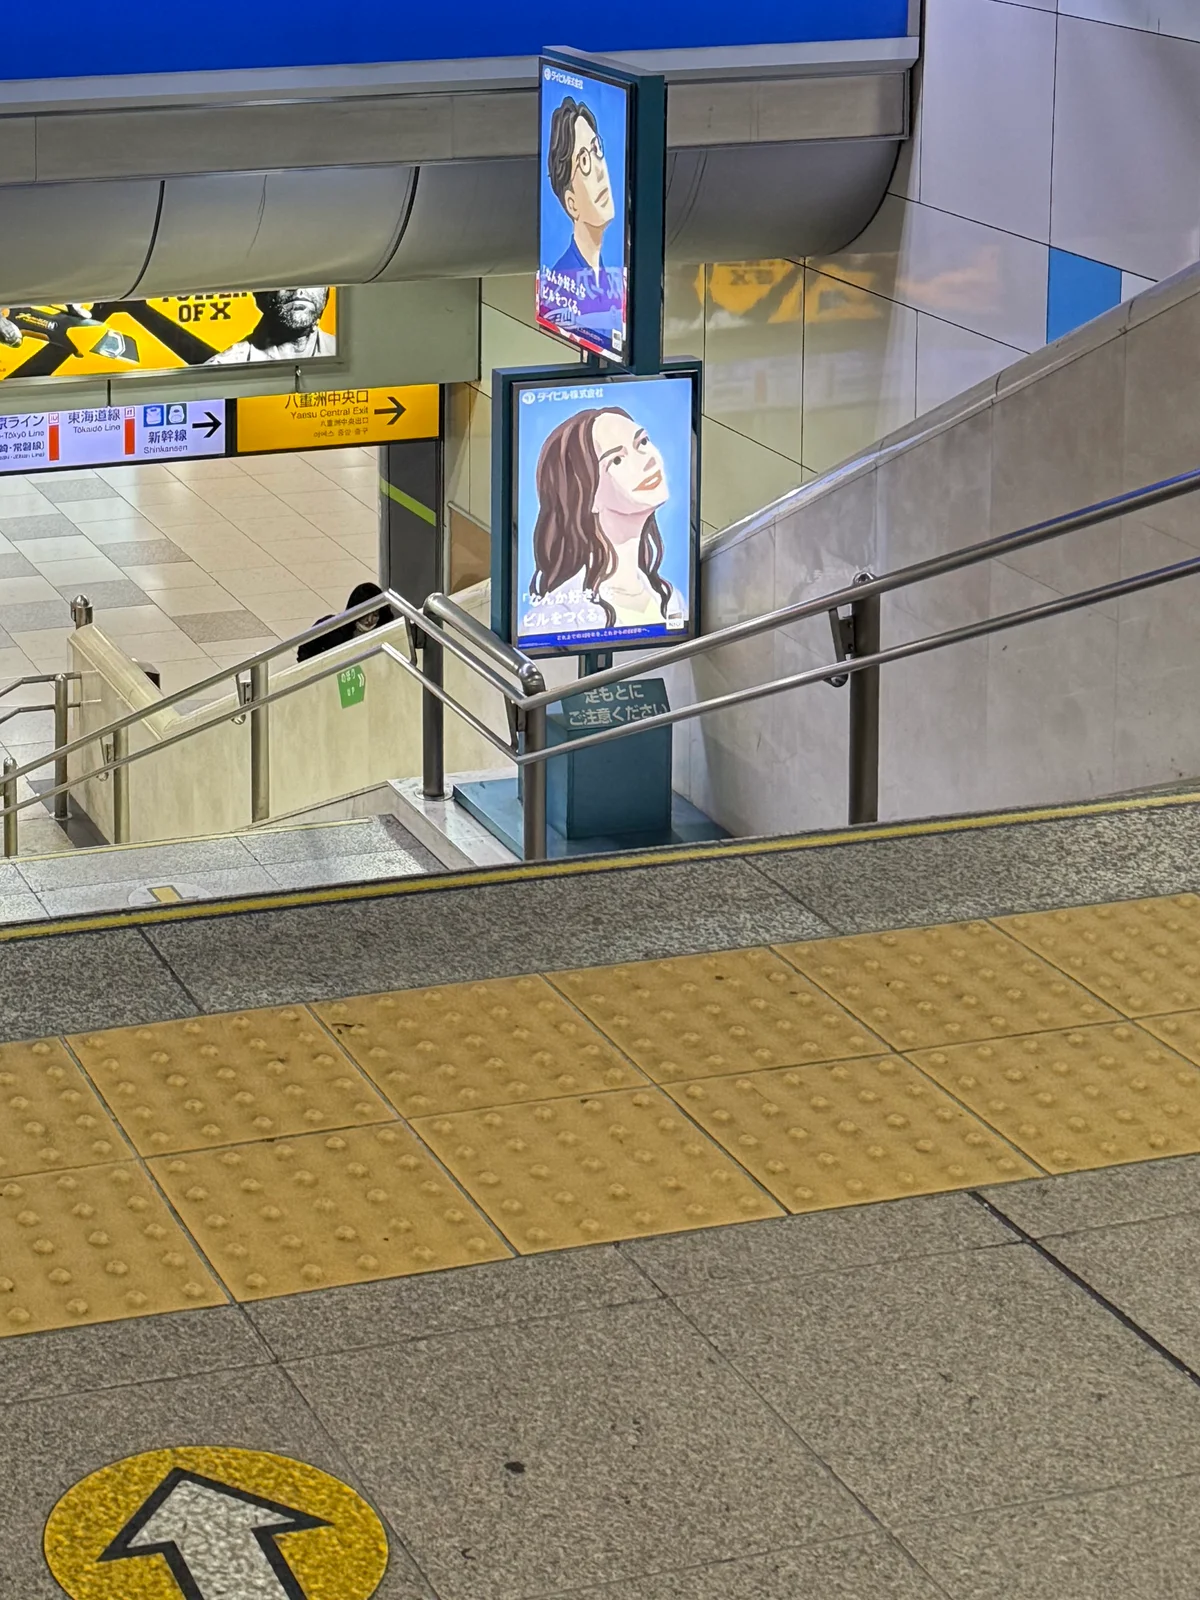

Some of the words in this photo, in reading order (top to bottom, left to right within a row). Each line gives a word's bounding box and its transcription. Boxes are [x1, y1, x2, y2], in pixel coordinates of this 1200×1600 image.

[178, 303, 205, 323] OF
[209, 302, 231, 320] X
[284, 390, 369, 409] 八重洲中央口
[67, 409, 121, 424] 東海道線
[290, 411, 318, 420] Yaesu
[319, 407, 350, 418] Central
[353, 406, 369, 415] Exit
[148, 430, 187, 444] 新幹線
[143, 445, 188, 454] Shinkansen
[584, 684, 644, 704] 足もとに
[569, 703, 668, 726] ご注意ください
